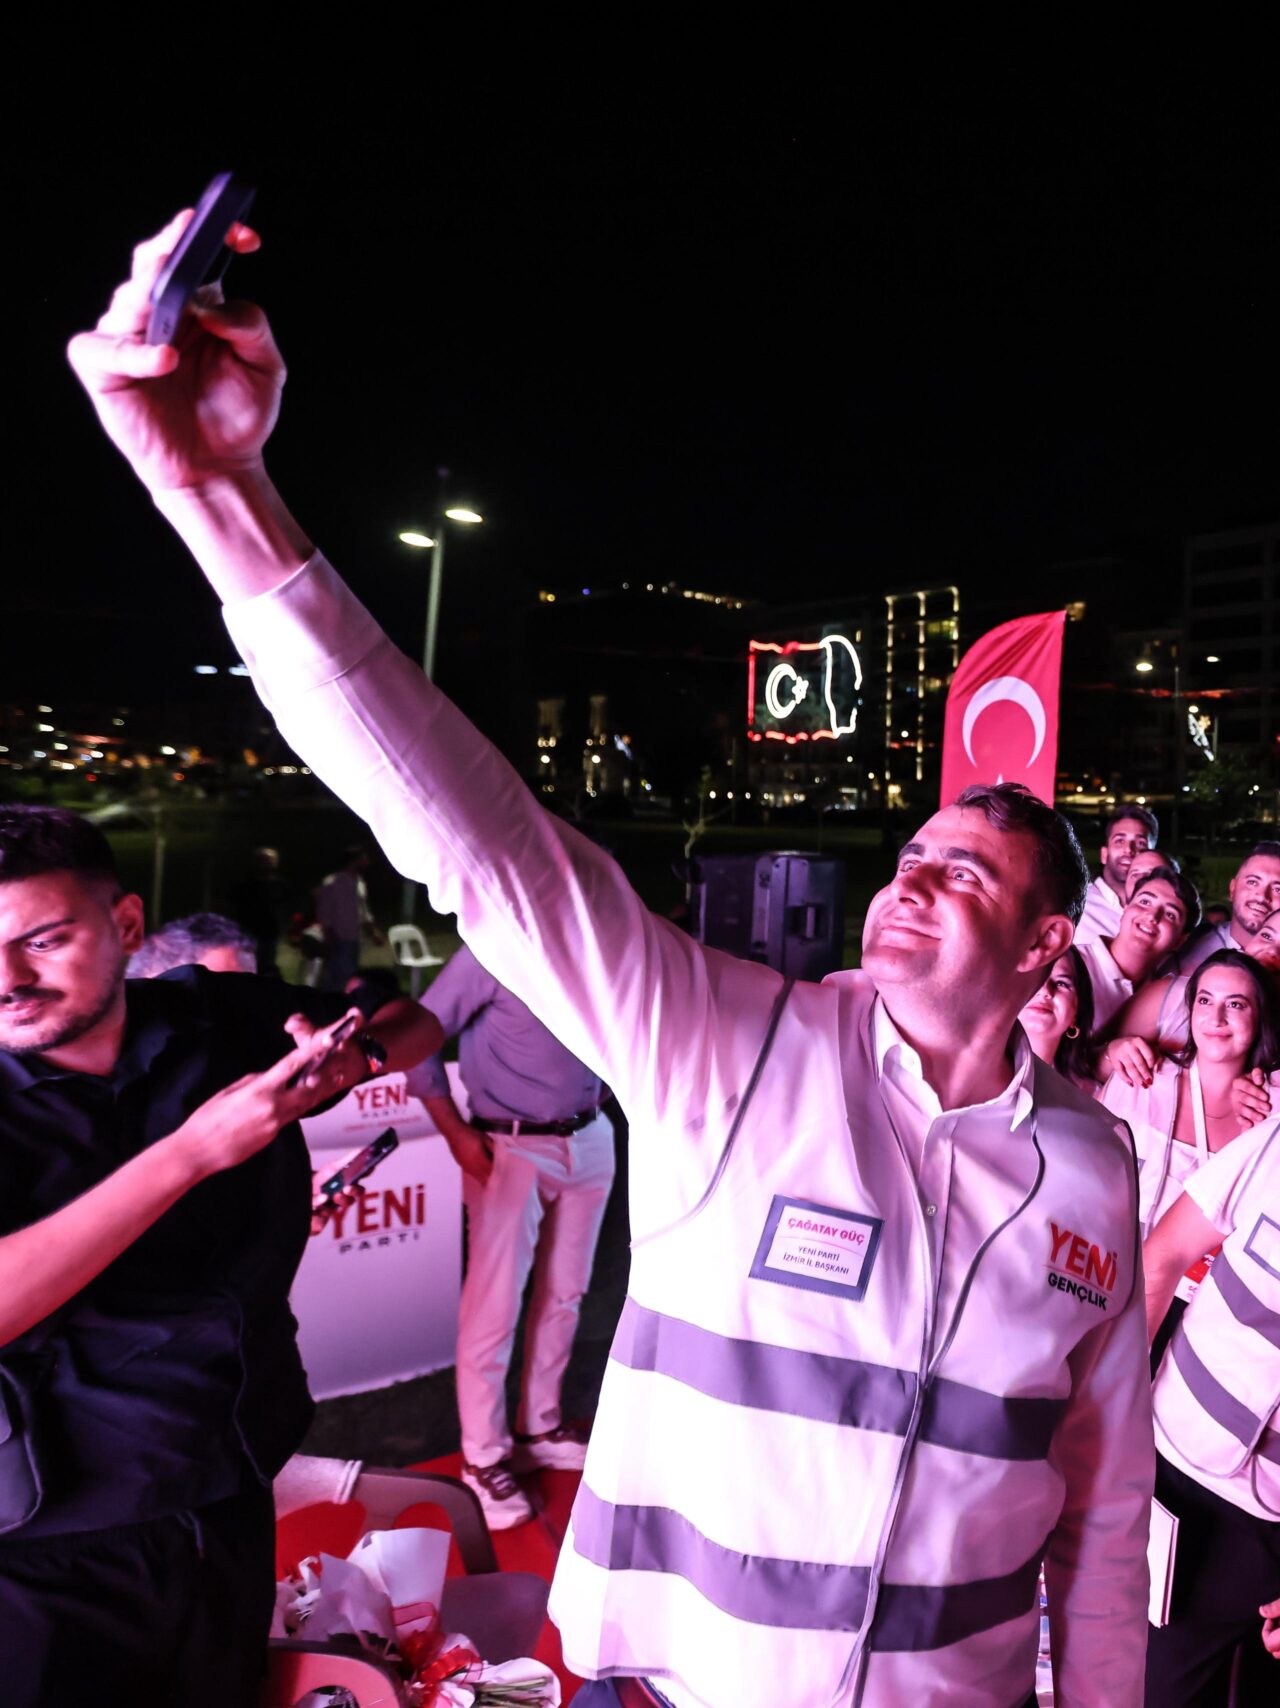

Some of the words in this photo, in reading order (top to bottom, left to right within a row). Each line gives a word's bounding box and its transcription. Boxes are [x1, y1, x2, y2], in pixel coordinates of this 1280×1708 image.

[788, 1217, 839, 1238] ÇAĞATAY
[839, 1230, 865, 1246] GÜÇ
[783, 1252, 805, 1266] İZMİR
[806, 1257, 814, 1268] İL
[814, 1260, 850, 1275] BAŞKANI
[798, 1245, 817, 1256] YENİ
[817, 1249, 840, 1262] PARTİ
